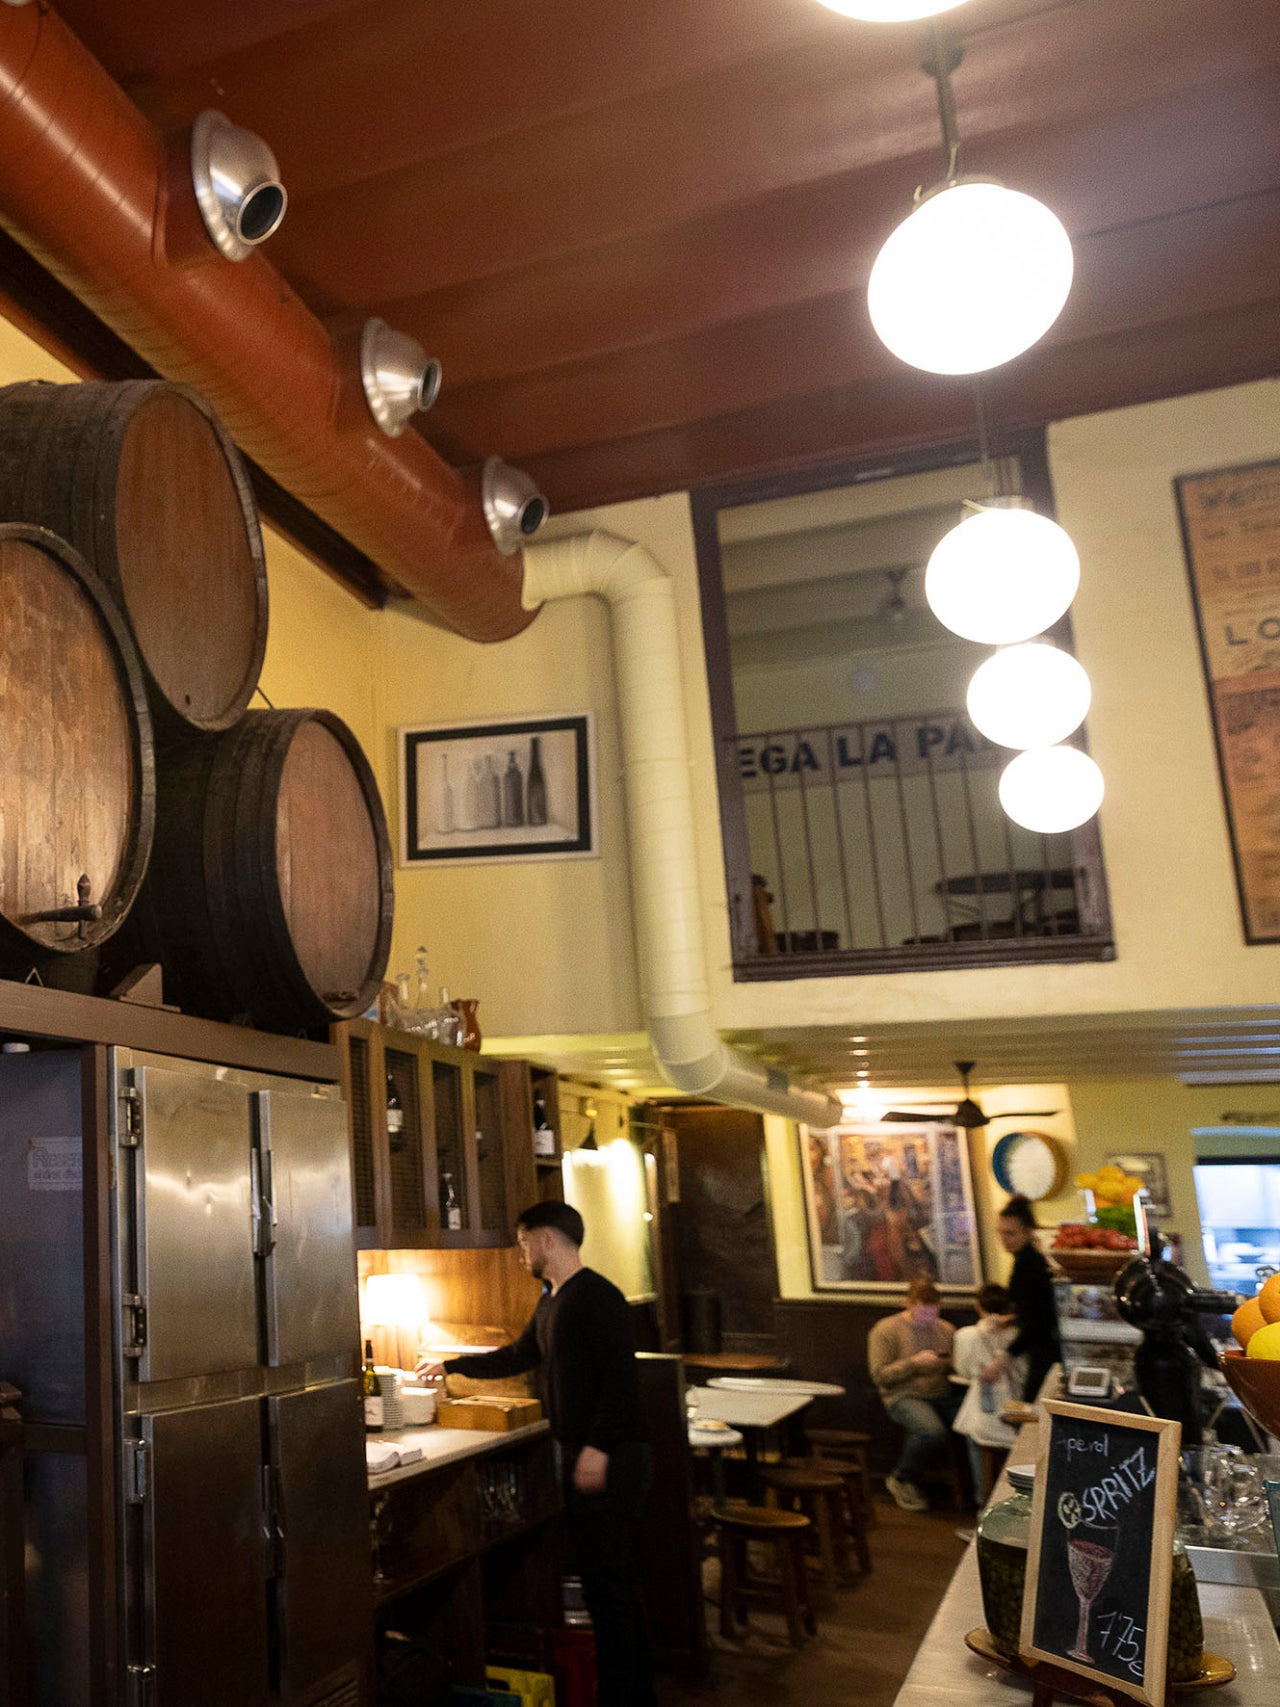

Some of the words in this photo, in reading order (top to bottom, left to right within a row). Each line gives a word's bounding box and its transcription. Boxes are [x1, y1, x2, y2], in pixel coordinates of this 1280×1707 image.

[836, 731, 898, 768] LA
[915, 722, 988, 758] PA
[1082, 1446, 1156, 1521] SPRITZ
